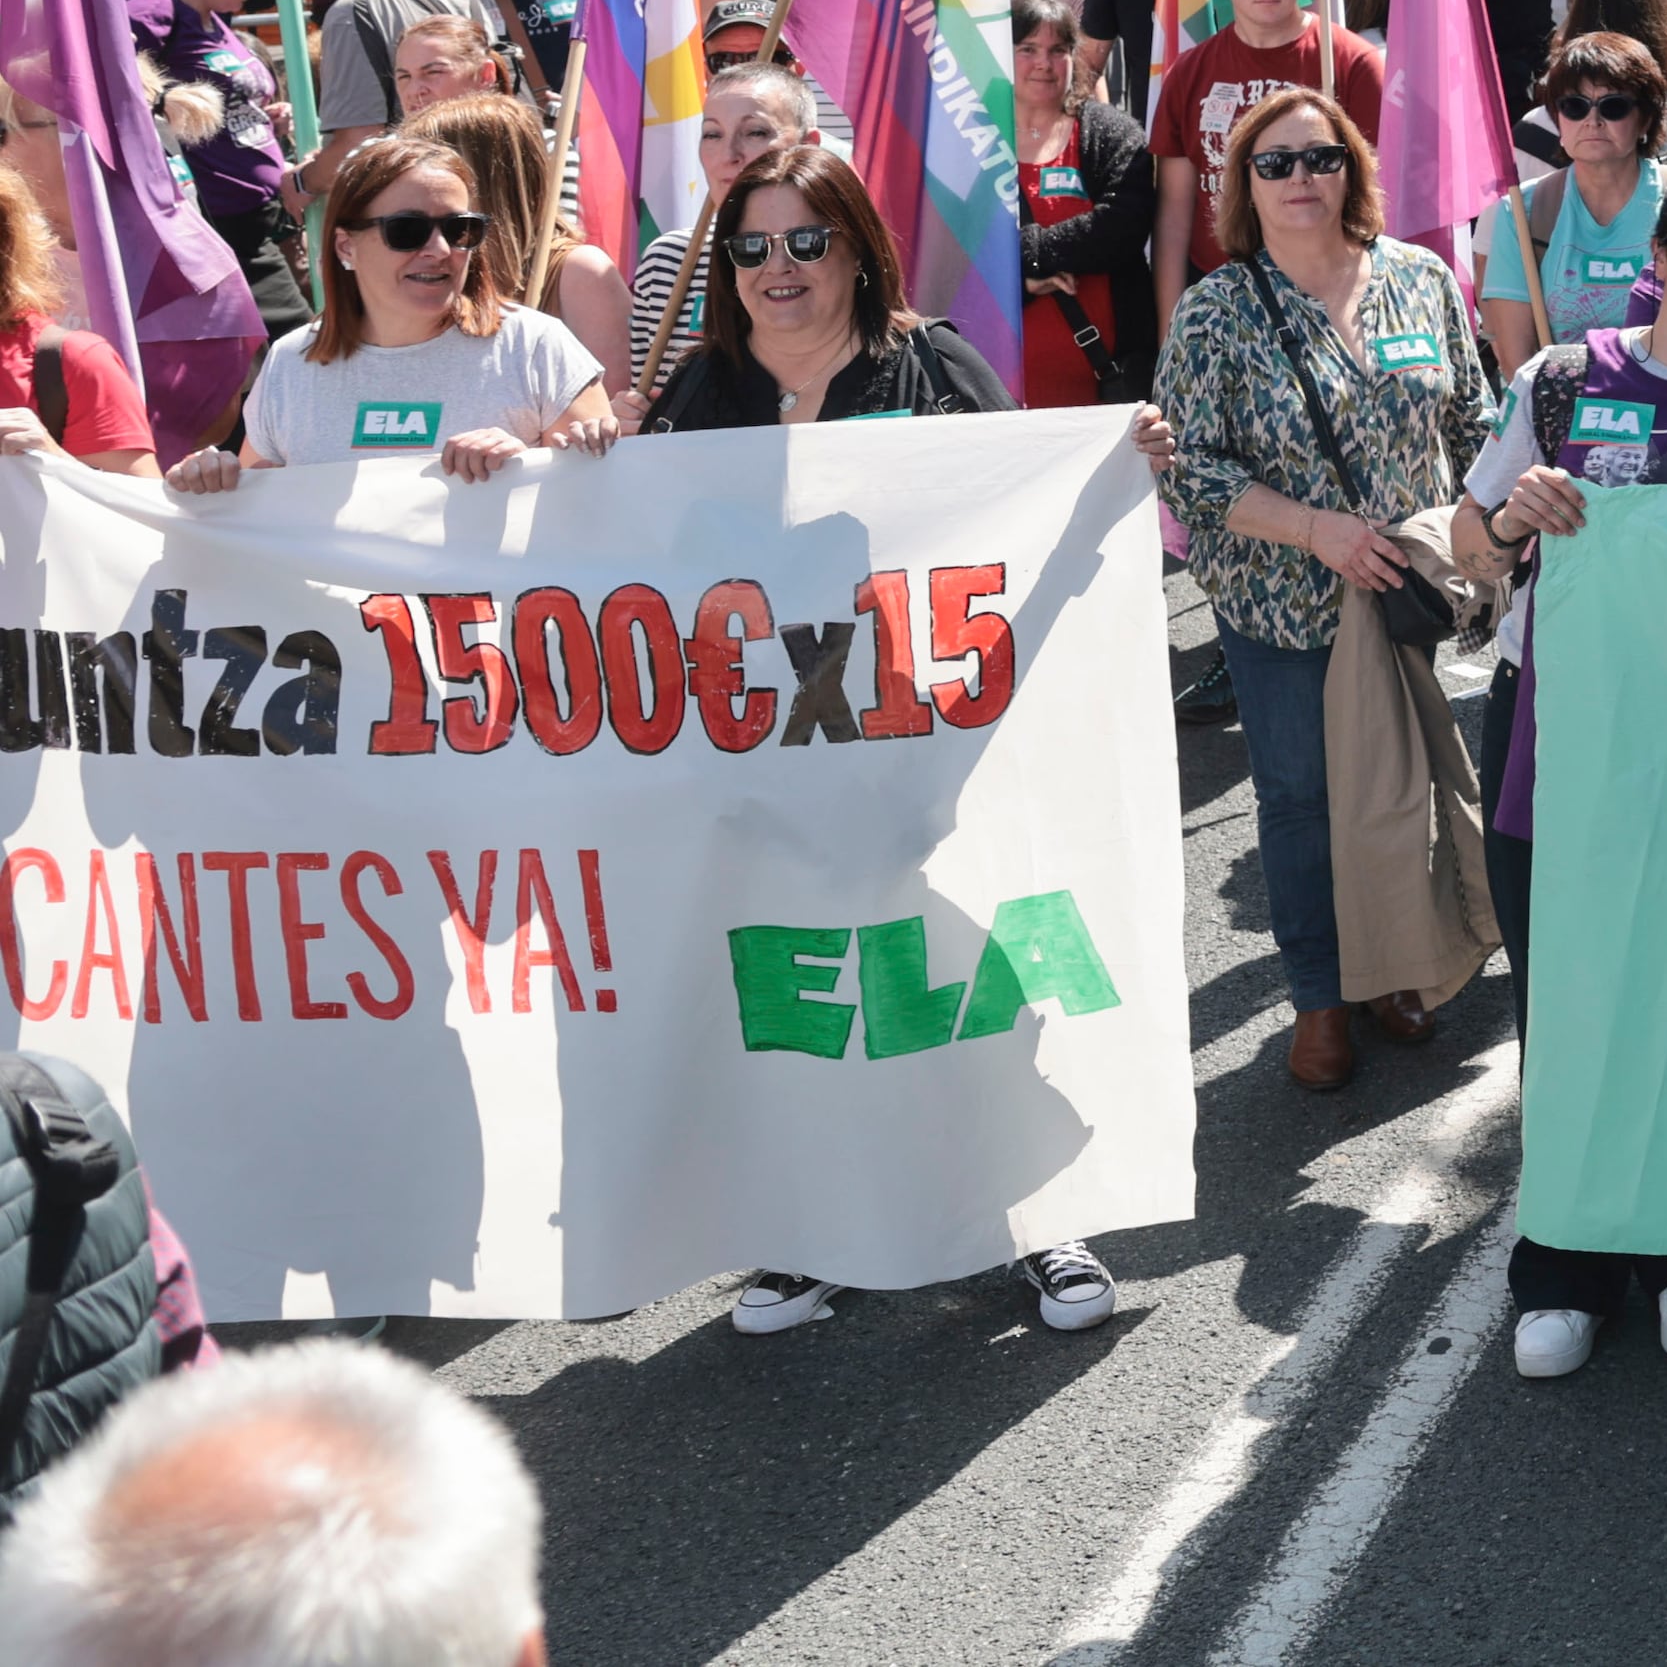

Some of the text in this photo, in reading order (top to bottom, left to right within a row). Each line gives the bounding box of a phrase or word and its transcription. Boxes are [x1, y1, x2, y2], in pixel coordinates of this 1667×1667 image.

[1045, 172, 1084, 192] ELA
[1588, 261, 1636, 279] ELA
[1382, 339, 1435, 362] ELA
[362, 410, 428, 435] ELA
[1579, 405, 1641, 436] ELA
[0, 847, 618, 1024] CANTES YA!
[728, 888, 1121, 1062] ELA
